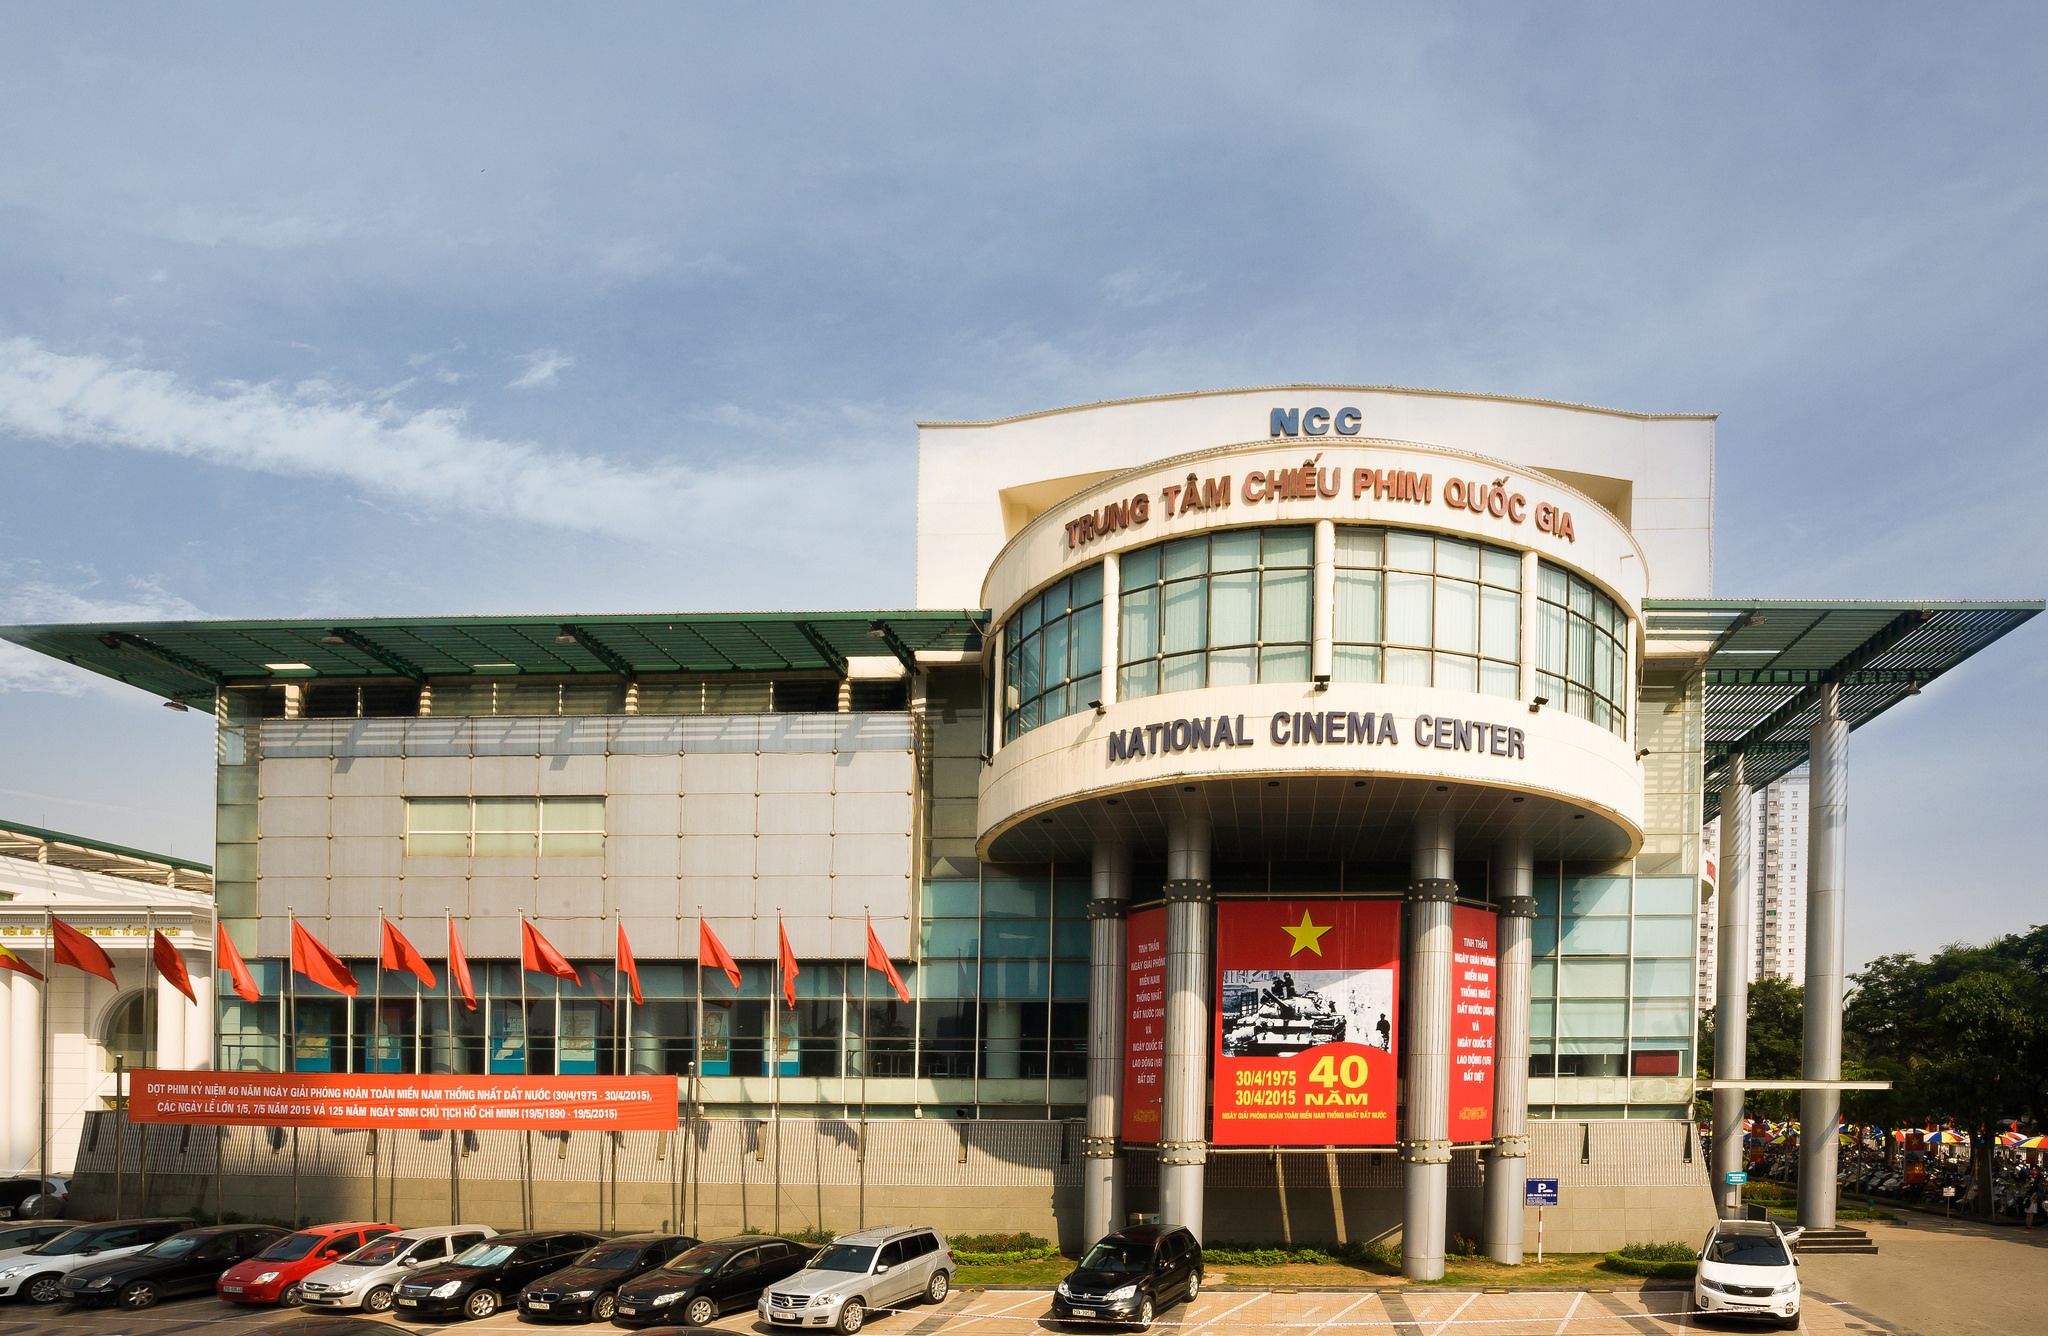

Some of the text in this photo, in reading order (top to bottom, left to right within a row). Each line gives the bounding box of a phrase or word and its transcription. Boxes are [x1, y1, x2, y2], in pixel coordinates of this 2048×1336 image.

[1270, 406, 1362, 437] NCC
[1065, 452, 1575, 549] TRUNG TÂM CHIẾU PHIM QUỐC GIA
[1109, 711, 1525, 761] NATIONAL CINEMA CENTER
[1472, 1020, 1479, 1031] VÀ
[1457, 1055, 1467, 1064] LAO
[1236, 1070, 1296, 1087] 30/4/1975
[1309, 1055, 1368, 1088] 40
[168, 1084, 189, 1094] PHIM
[191, 1081, 203, 1094] KỶ
[205, 1083, 226, 1098] NIỆM
[228, 1086, 239, 1096] 40
[241, 1085, 260, 1096] NĂM
[263, 1085, 288, 1097] NGÀY
[291, 1084, 308, 1097] GIẢI
[311, 1086, 340, 1098] PHÓNG
[343, 1086, 368, 1098] HOÀN
[370, 1087, 395, 1099] TOÀN
[422, 1089, 442, 1099] NAM
[444, 1086, 474, 1100] THỐNG
[478, 1086, 502, 1100] NHẤT
[504, 1087, 522, 1099] ĐẤT
[525, 1088, 550, 1100] NƯỚC
[553, 1090, 597, 1101] (30/4/1975
[605, 1090, 652, 1101] 30/4/2015),
[1235, 1090, 1296, 1106] 30/4/2015
[1305, 1090, 1368, 1105] NĂM
[157, 1100, 176, 1112] CÁC
[178, 1100, 202, 1112] NGÀY
[237, 1104, 251, 1114] 1/5,
[253, 1104, 265, 1114] 7/5
[290, 1105, 310, 1115] 2015
[313, 1103, 325, 1115] VÀ
[329, 1106, 343, 1116] 125
[346, 1104, 367, 1116] NĂM
[370, 1105, 395, 1117] NGÀY
[397, 1108, 418, 1118] SINH
[420, 1104, 439, 1118] CHỦ
[442, 1108, 461, 1120] TỊCH
[496, 1109, 519, 1119] MINH
[522, 1109, 565, 1120] (19/5/1890
[573, 1109, 617, 1120] 19/5/2015)
[1538, 1183, 1547, 1193] P
